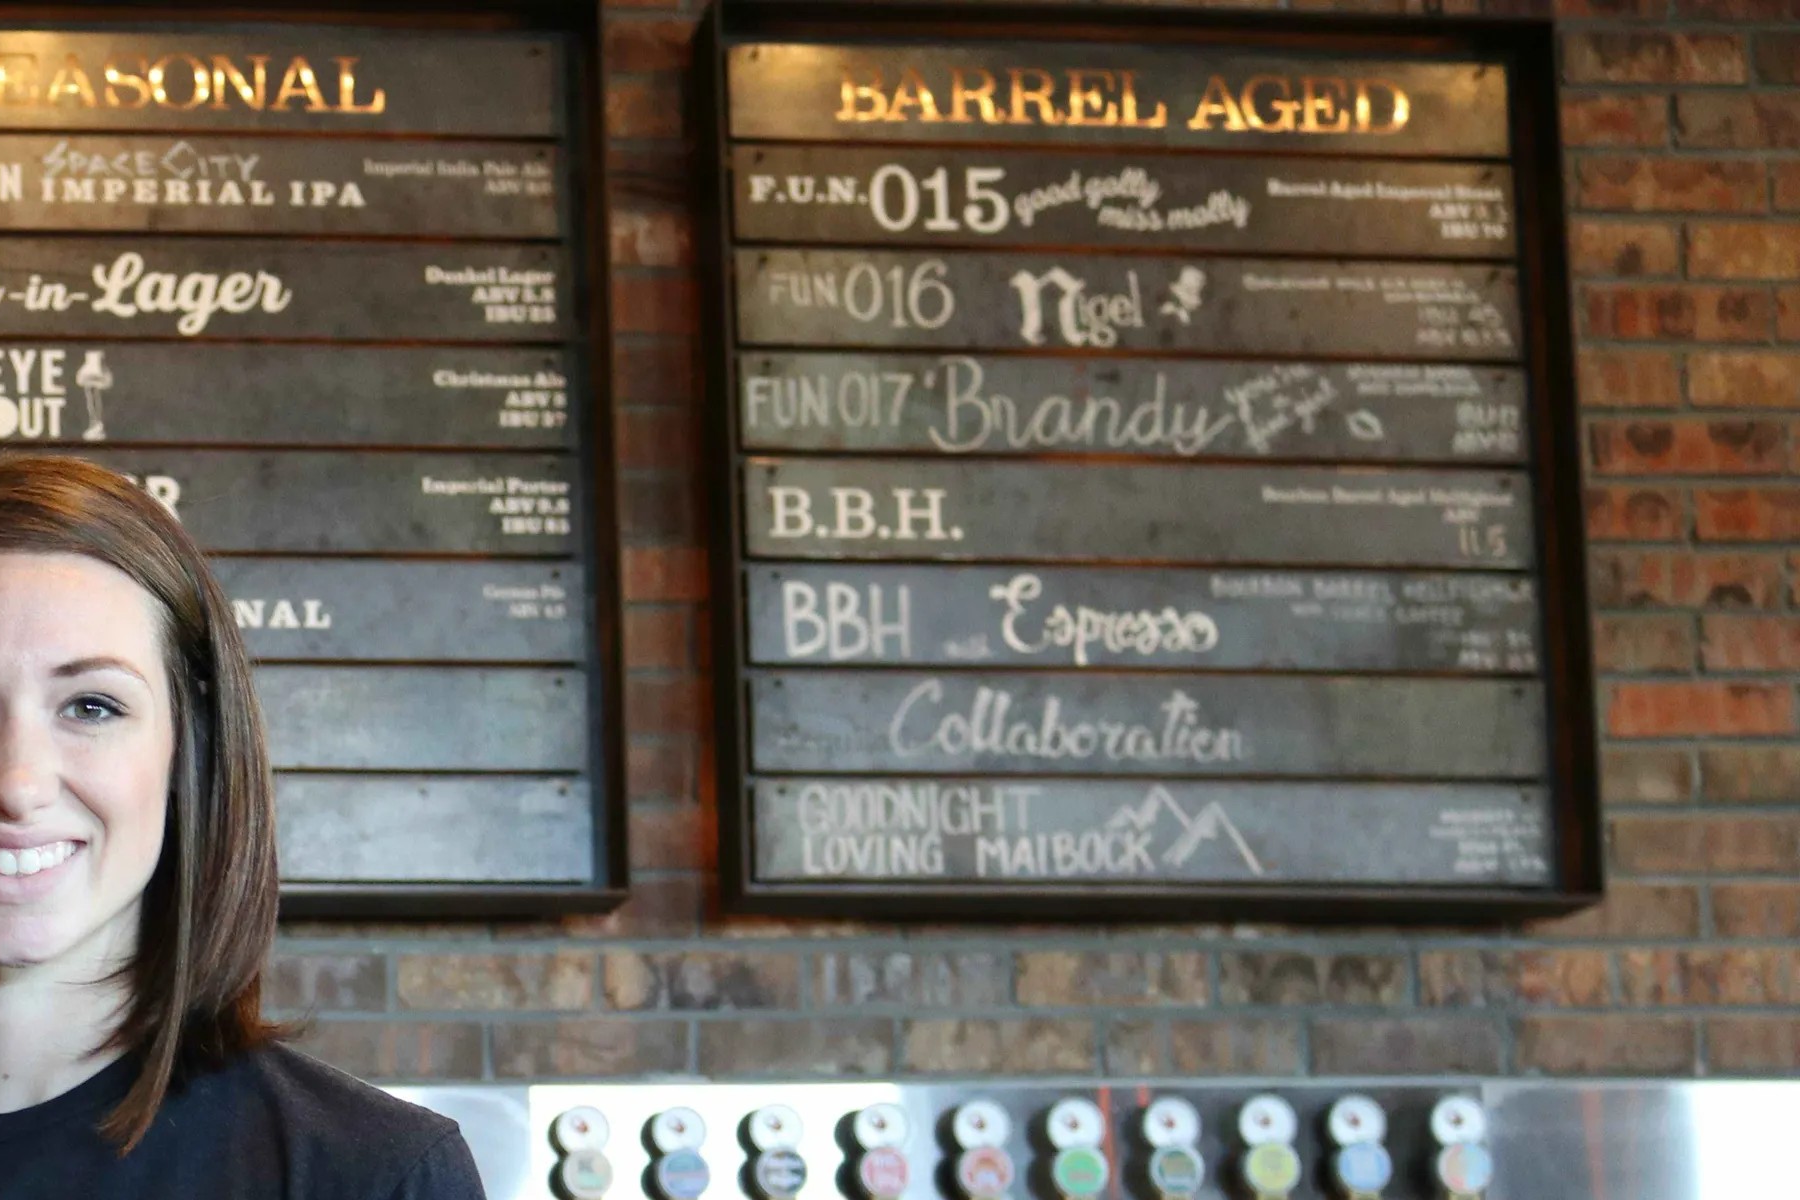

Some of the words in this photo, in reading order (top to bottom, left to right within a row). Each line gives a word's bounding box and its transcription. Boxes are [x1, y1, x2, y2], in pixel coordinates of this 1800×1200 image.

[835, 66, 1168, 129] BARREL
[1187, 73, 1411, 135] AGED
[42, 139, 157, 178] SPACE
[41, 177, 276, 207] IMPERIAL
[289, 180, 367, 208] IPA
[749, 174, 868, 205] F.U.N.
[870, 163, 1010, 233] 015
[843, 260, 958, 330] 016
[767, 486, 966, 541] B.B.H.
[782, 579, 912, 660] BBH
[988, 573, 1219, 667] Espresso
[802, 784, 1042, 836] GOODNIGHT
[802, 834, 946, 876] LOVING
[973, 830, 1156, 880] MAIBOCK
